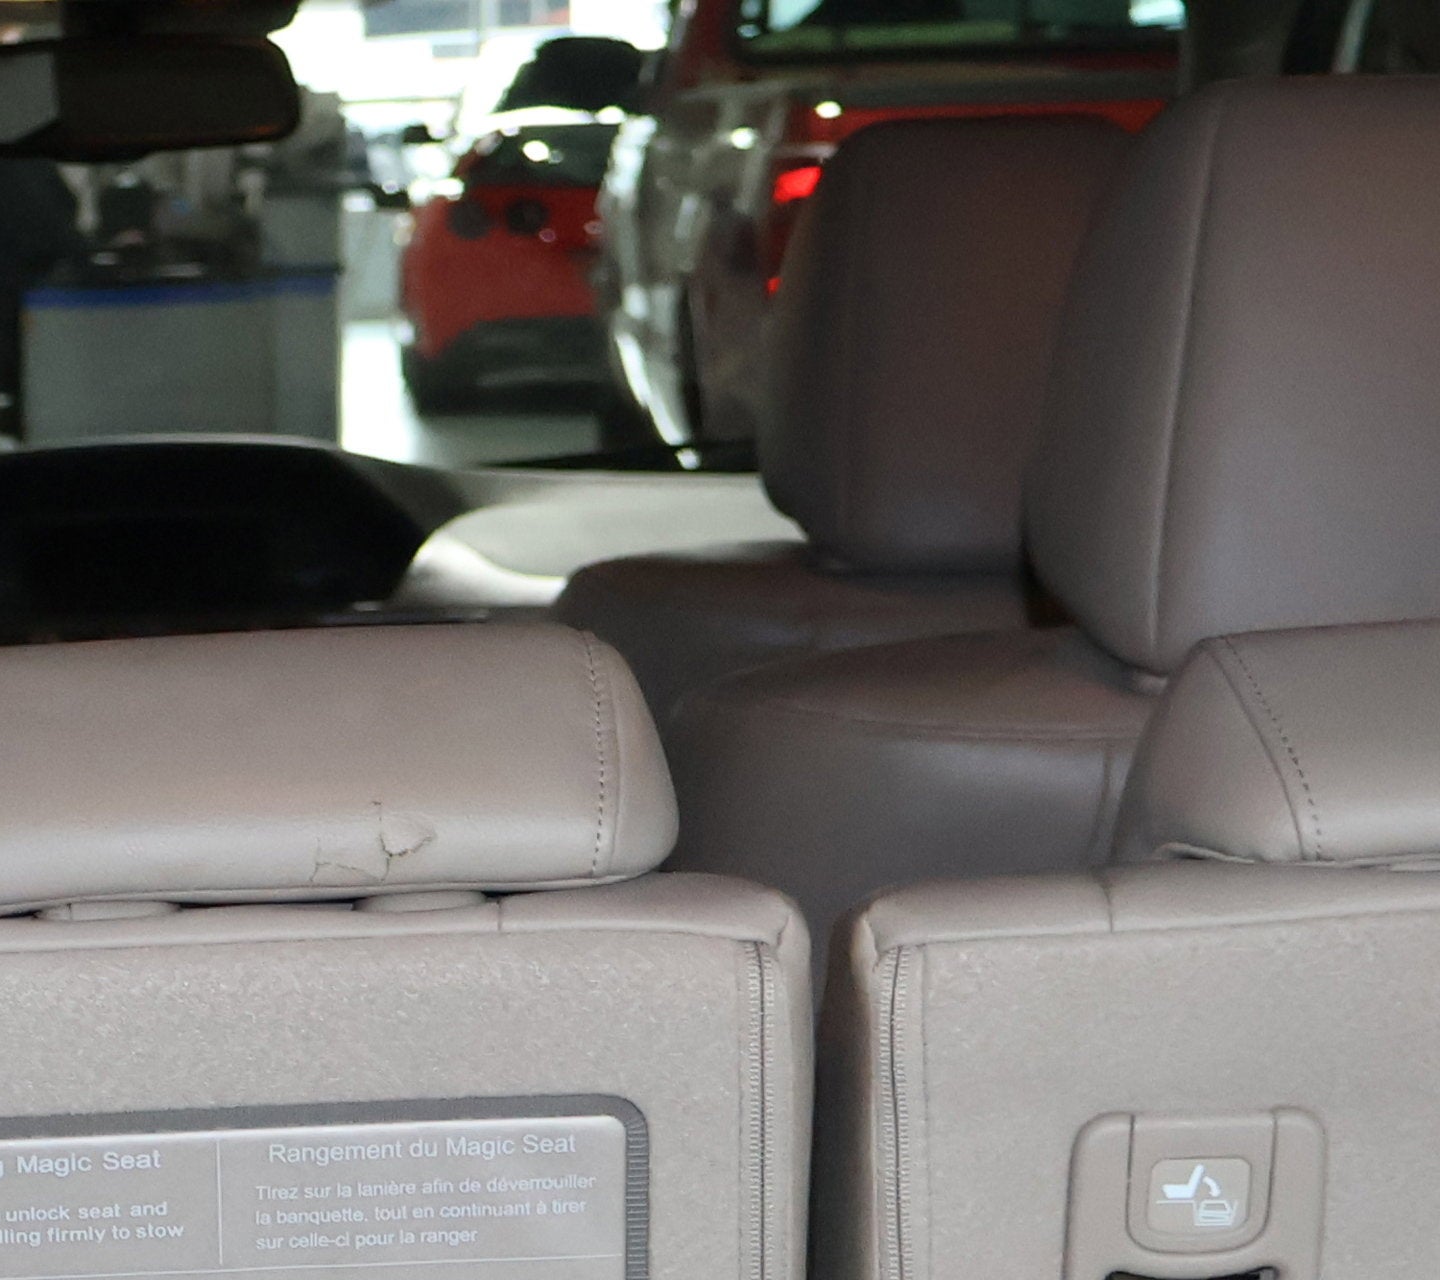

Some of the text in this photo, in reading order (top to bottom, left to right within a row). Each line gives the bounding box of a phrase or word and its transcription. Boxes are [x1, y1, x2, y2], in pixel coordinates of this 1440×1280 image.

[269, 1133, 576, 1166] Rangement du Magic Seat
[17, 1153, 92, 1177] Magic
[102, 1150, 161, 1171] Seat
[255, 1174, 597, 1200] Tirez sur la lanière afin de déverrouiller
[5, 1205, 70, 1222] unlock
[78, 1203, 120, 1219] seat
[130, 1201, 168, 1218] and
[255, 1210, 271, 1225] la
[374, 1205, 407, 1221] tout
[412, 1206, 435, 1219] en
[439, 1202, 530, 1218] continuant
[536, 1200, 547, 1215] à
[552, 1198, 586, 1214] tirer
[47, 1226, 105, 1244] firmly
[112, 1225, 130, 1240] to
[135, 1223, 185, 1239] stow
[256, 1229, 478, 1250] sur celle-ci pour la ranger
